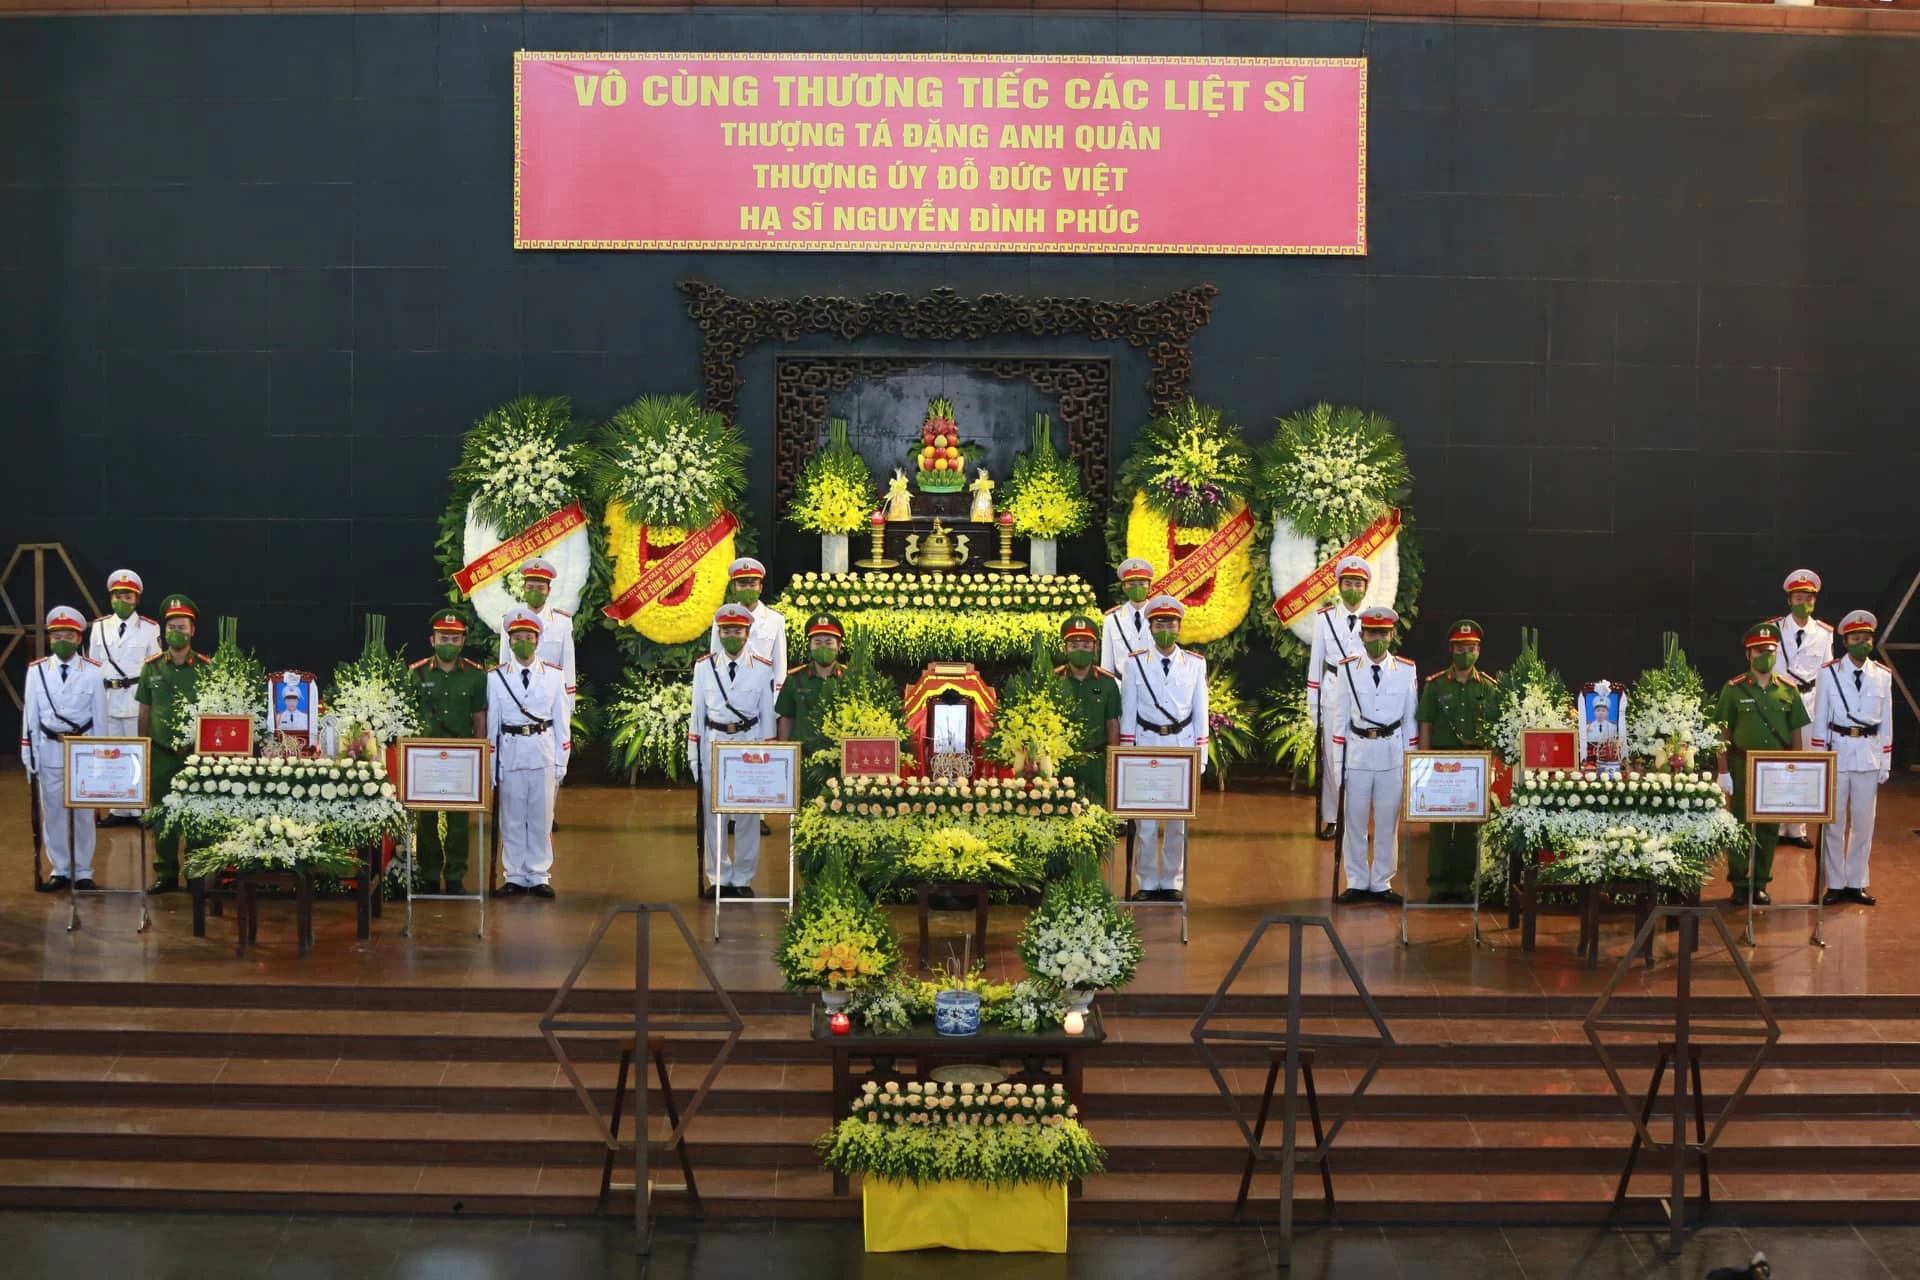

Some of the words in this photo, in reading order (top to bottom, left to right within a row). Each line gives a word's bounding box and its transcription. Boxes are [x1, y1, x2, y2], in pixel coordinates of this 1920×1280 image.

[574, 69, 627, 106] VÔ
[643, 69, 759, 107] CÙNG
[774, 73, 943, 107] THƯƠNG
[958, 67, 1049, 109] TIẾC
[1064, 72, 1149, 110] CÁC
[1165, 74, 1250, 118] LIỆT
[1264, 75, 1307, 112] SĨ
[721, 120, 844, 152] THƯỢNG
[856, 118, 892, 148] TÁ
[903, 119, 989, 152] ĐẶNG
[1000, 124, 1064, 149] ANH
[1075, 121, 1160, 151] QUÂN
[753, 162, 877, 194] THƯỢNG
[888, 160, 927, 190] ÚY
[938, 157, 979, 190] ĐỖ
[989, 163, 1052, 191] ĐỨC
[1063, 162, 1128, 196] VIỆT
[740, 206, 781, 235] HẠ
[792, 202, 824, 231] SĨ
[834, 199, 959, 232] NGUYỄN
[970, 203, 1045, 233] ĐÌNH
[1056, 204, 1139, 234] PHÚC
